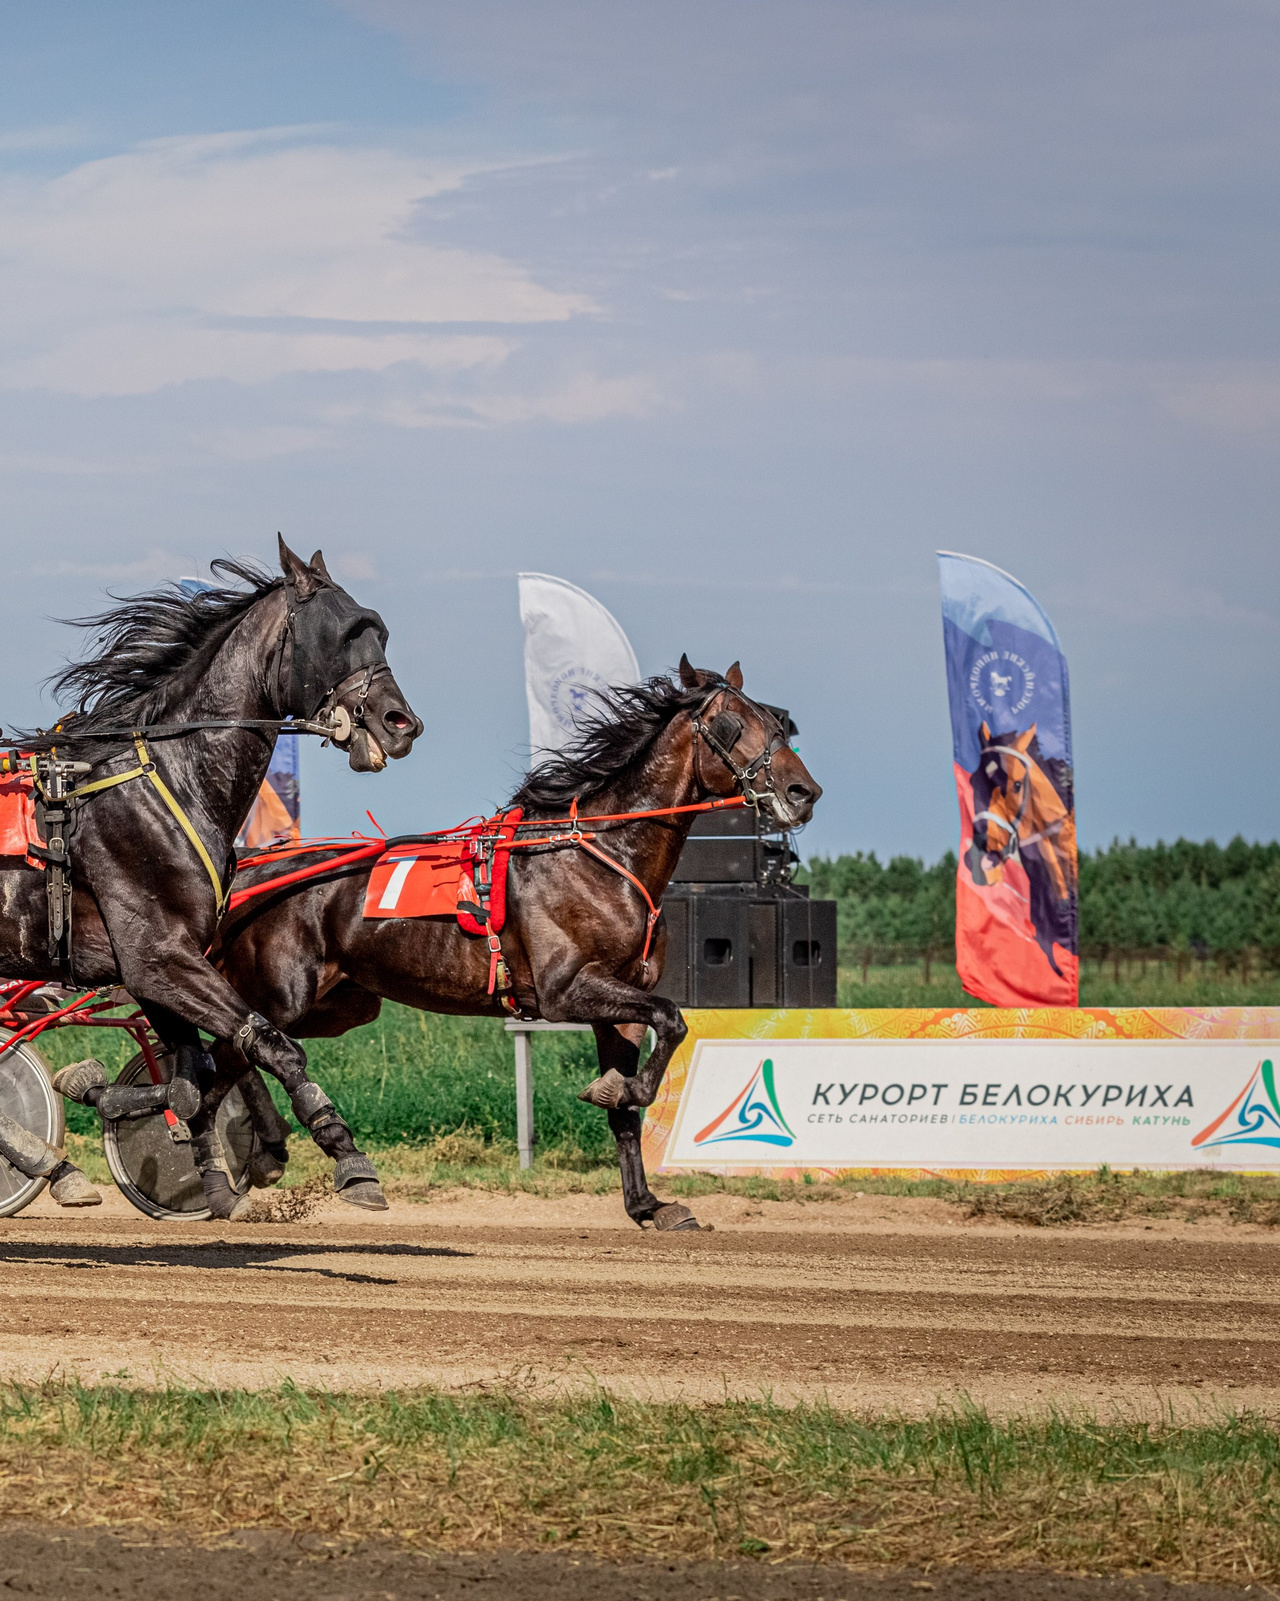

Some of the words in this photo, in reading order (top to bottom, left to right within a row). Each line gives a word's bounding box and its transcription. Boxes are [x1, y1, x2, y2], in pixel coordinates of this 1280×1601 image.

[812, 1083, 948, 1106] КУРОРТ
[959, 1084, 1194, 1107] БЕЛОКУРИХА
[807, 1113, 843, 1124] СЕТЬ
[849, 1114, 948, 1124] САНАТОРИЕВ
[959, 1114, 1058, 1125] БЕЛОКУРИХА
[1064, 1115, 1125, 1126] СИБИРЬ
[1132, 1115, 1191, 1126] КАТУНЬ
